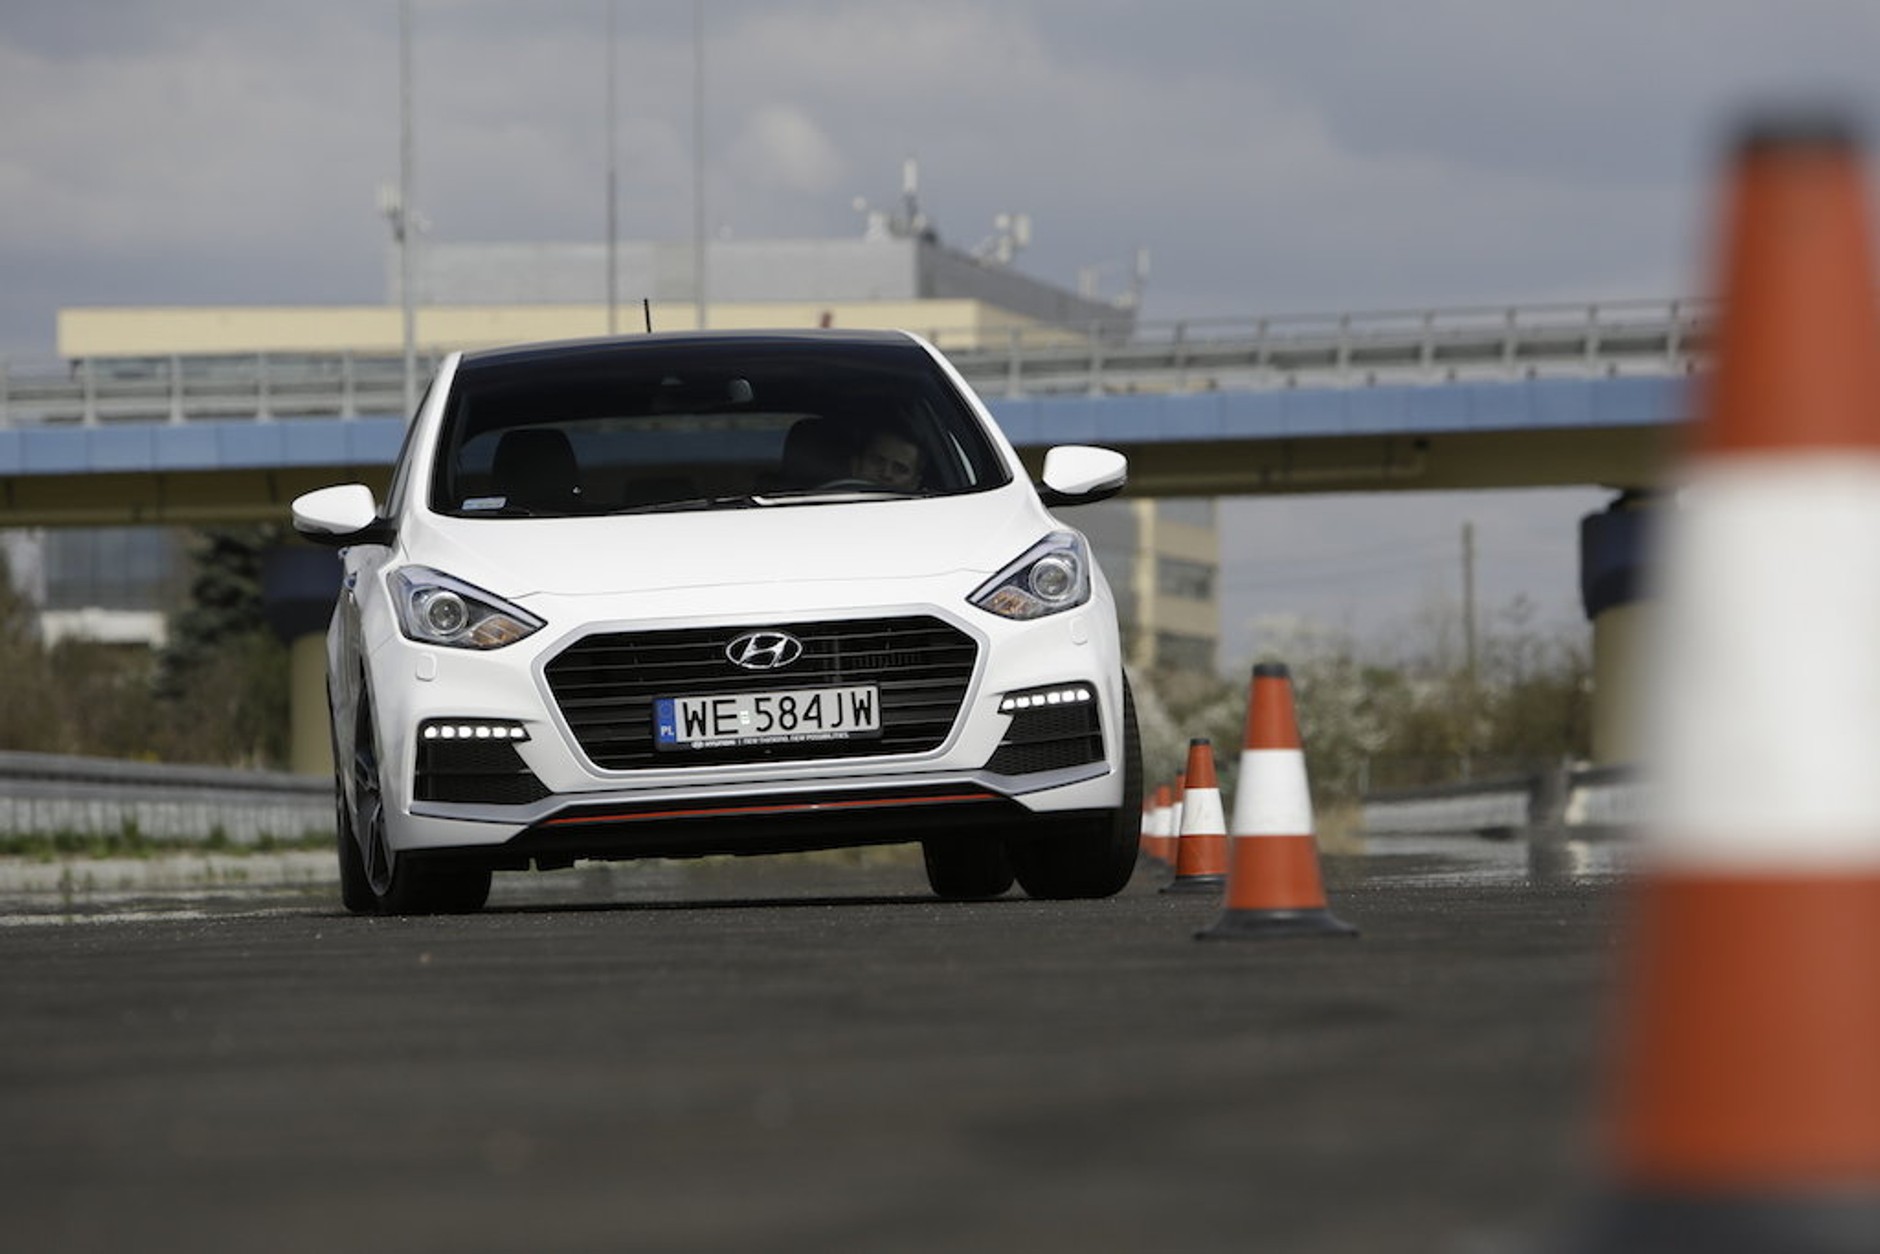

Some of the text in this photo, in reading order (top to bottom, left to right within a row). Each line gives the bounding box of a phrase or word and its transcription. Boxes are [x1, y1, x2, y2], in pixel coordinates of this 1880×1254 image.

[682, 690, 872, 737] WE 584JW
[660, 725, 675, 736] PL
